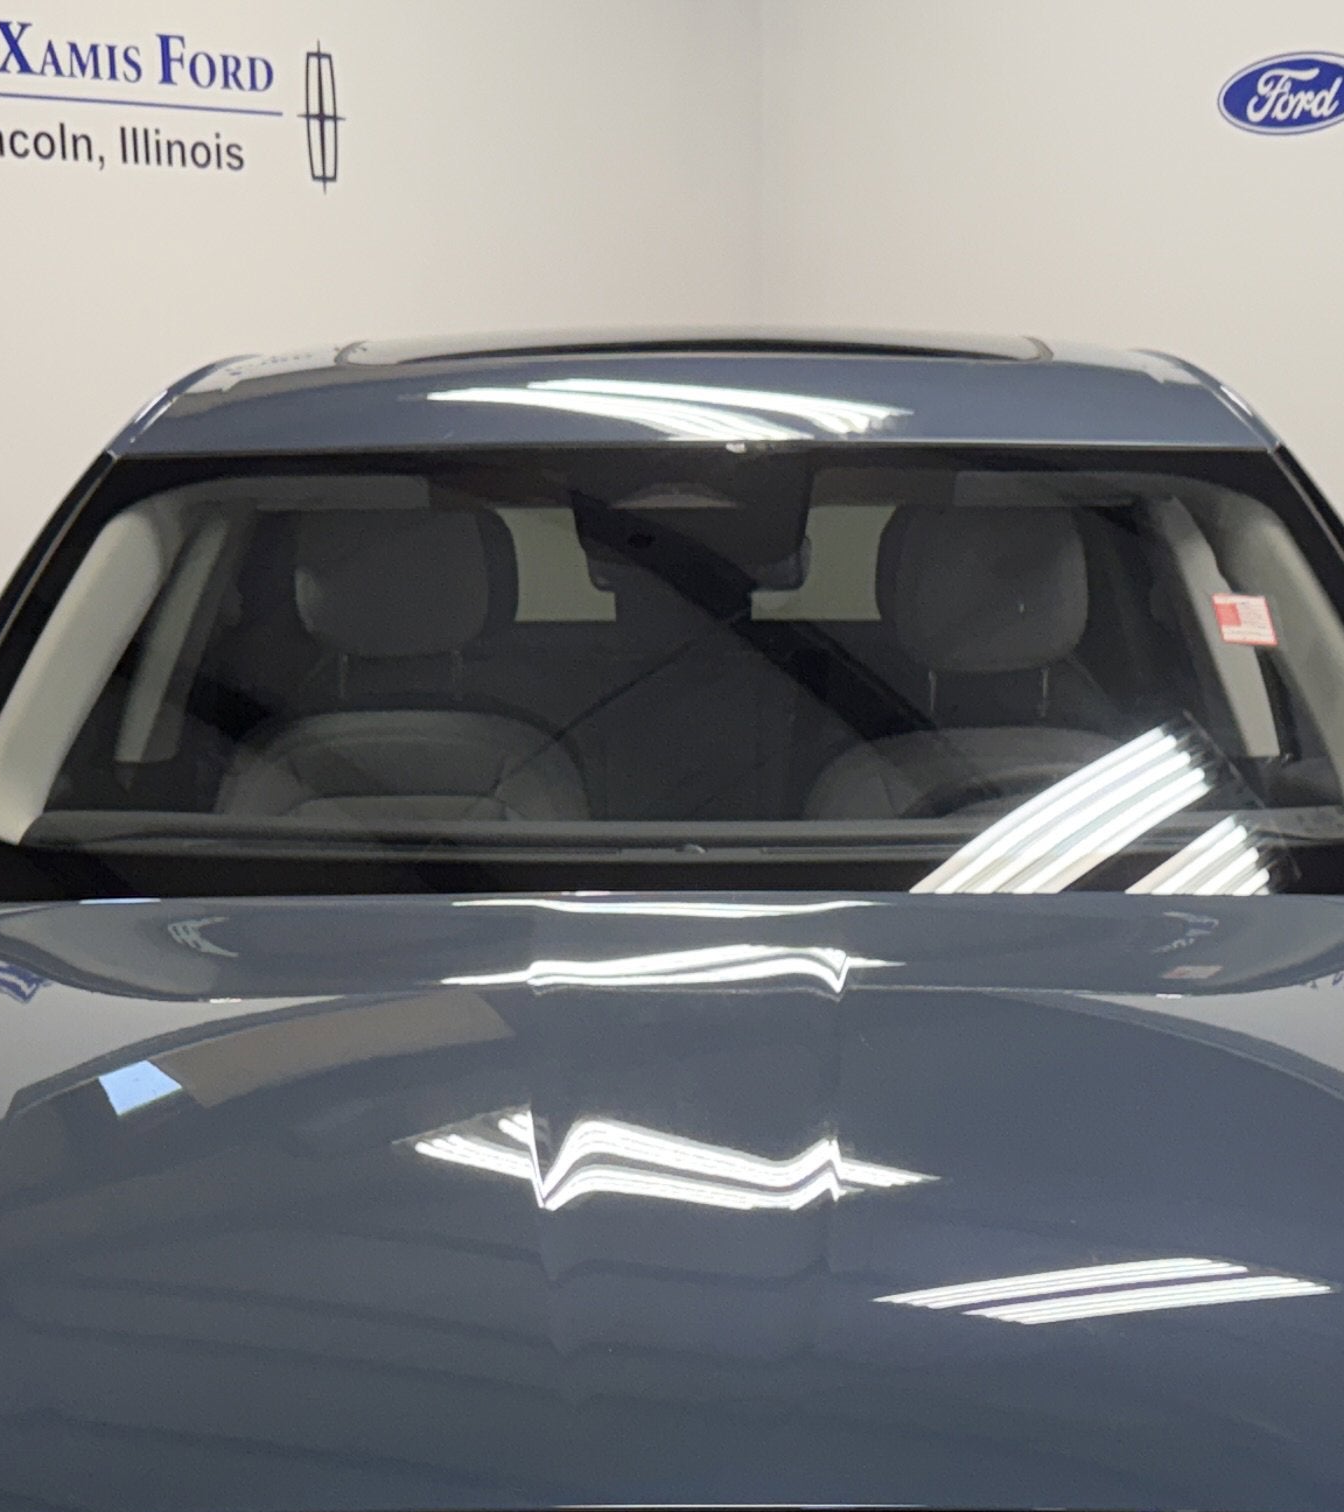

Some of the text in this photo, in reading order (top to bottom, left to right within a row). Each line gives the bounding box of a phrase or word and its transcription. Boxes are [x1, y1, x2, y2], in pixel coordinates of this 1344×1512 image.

[156, 33, 274, 93] FORD
[1246, 68, 1340, 122] Ford
[119, 126, 244, 171] Illinois
